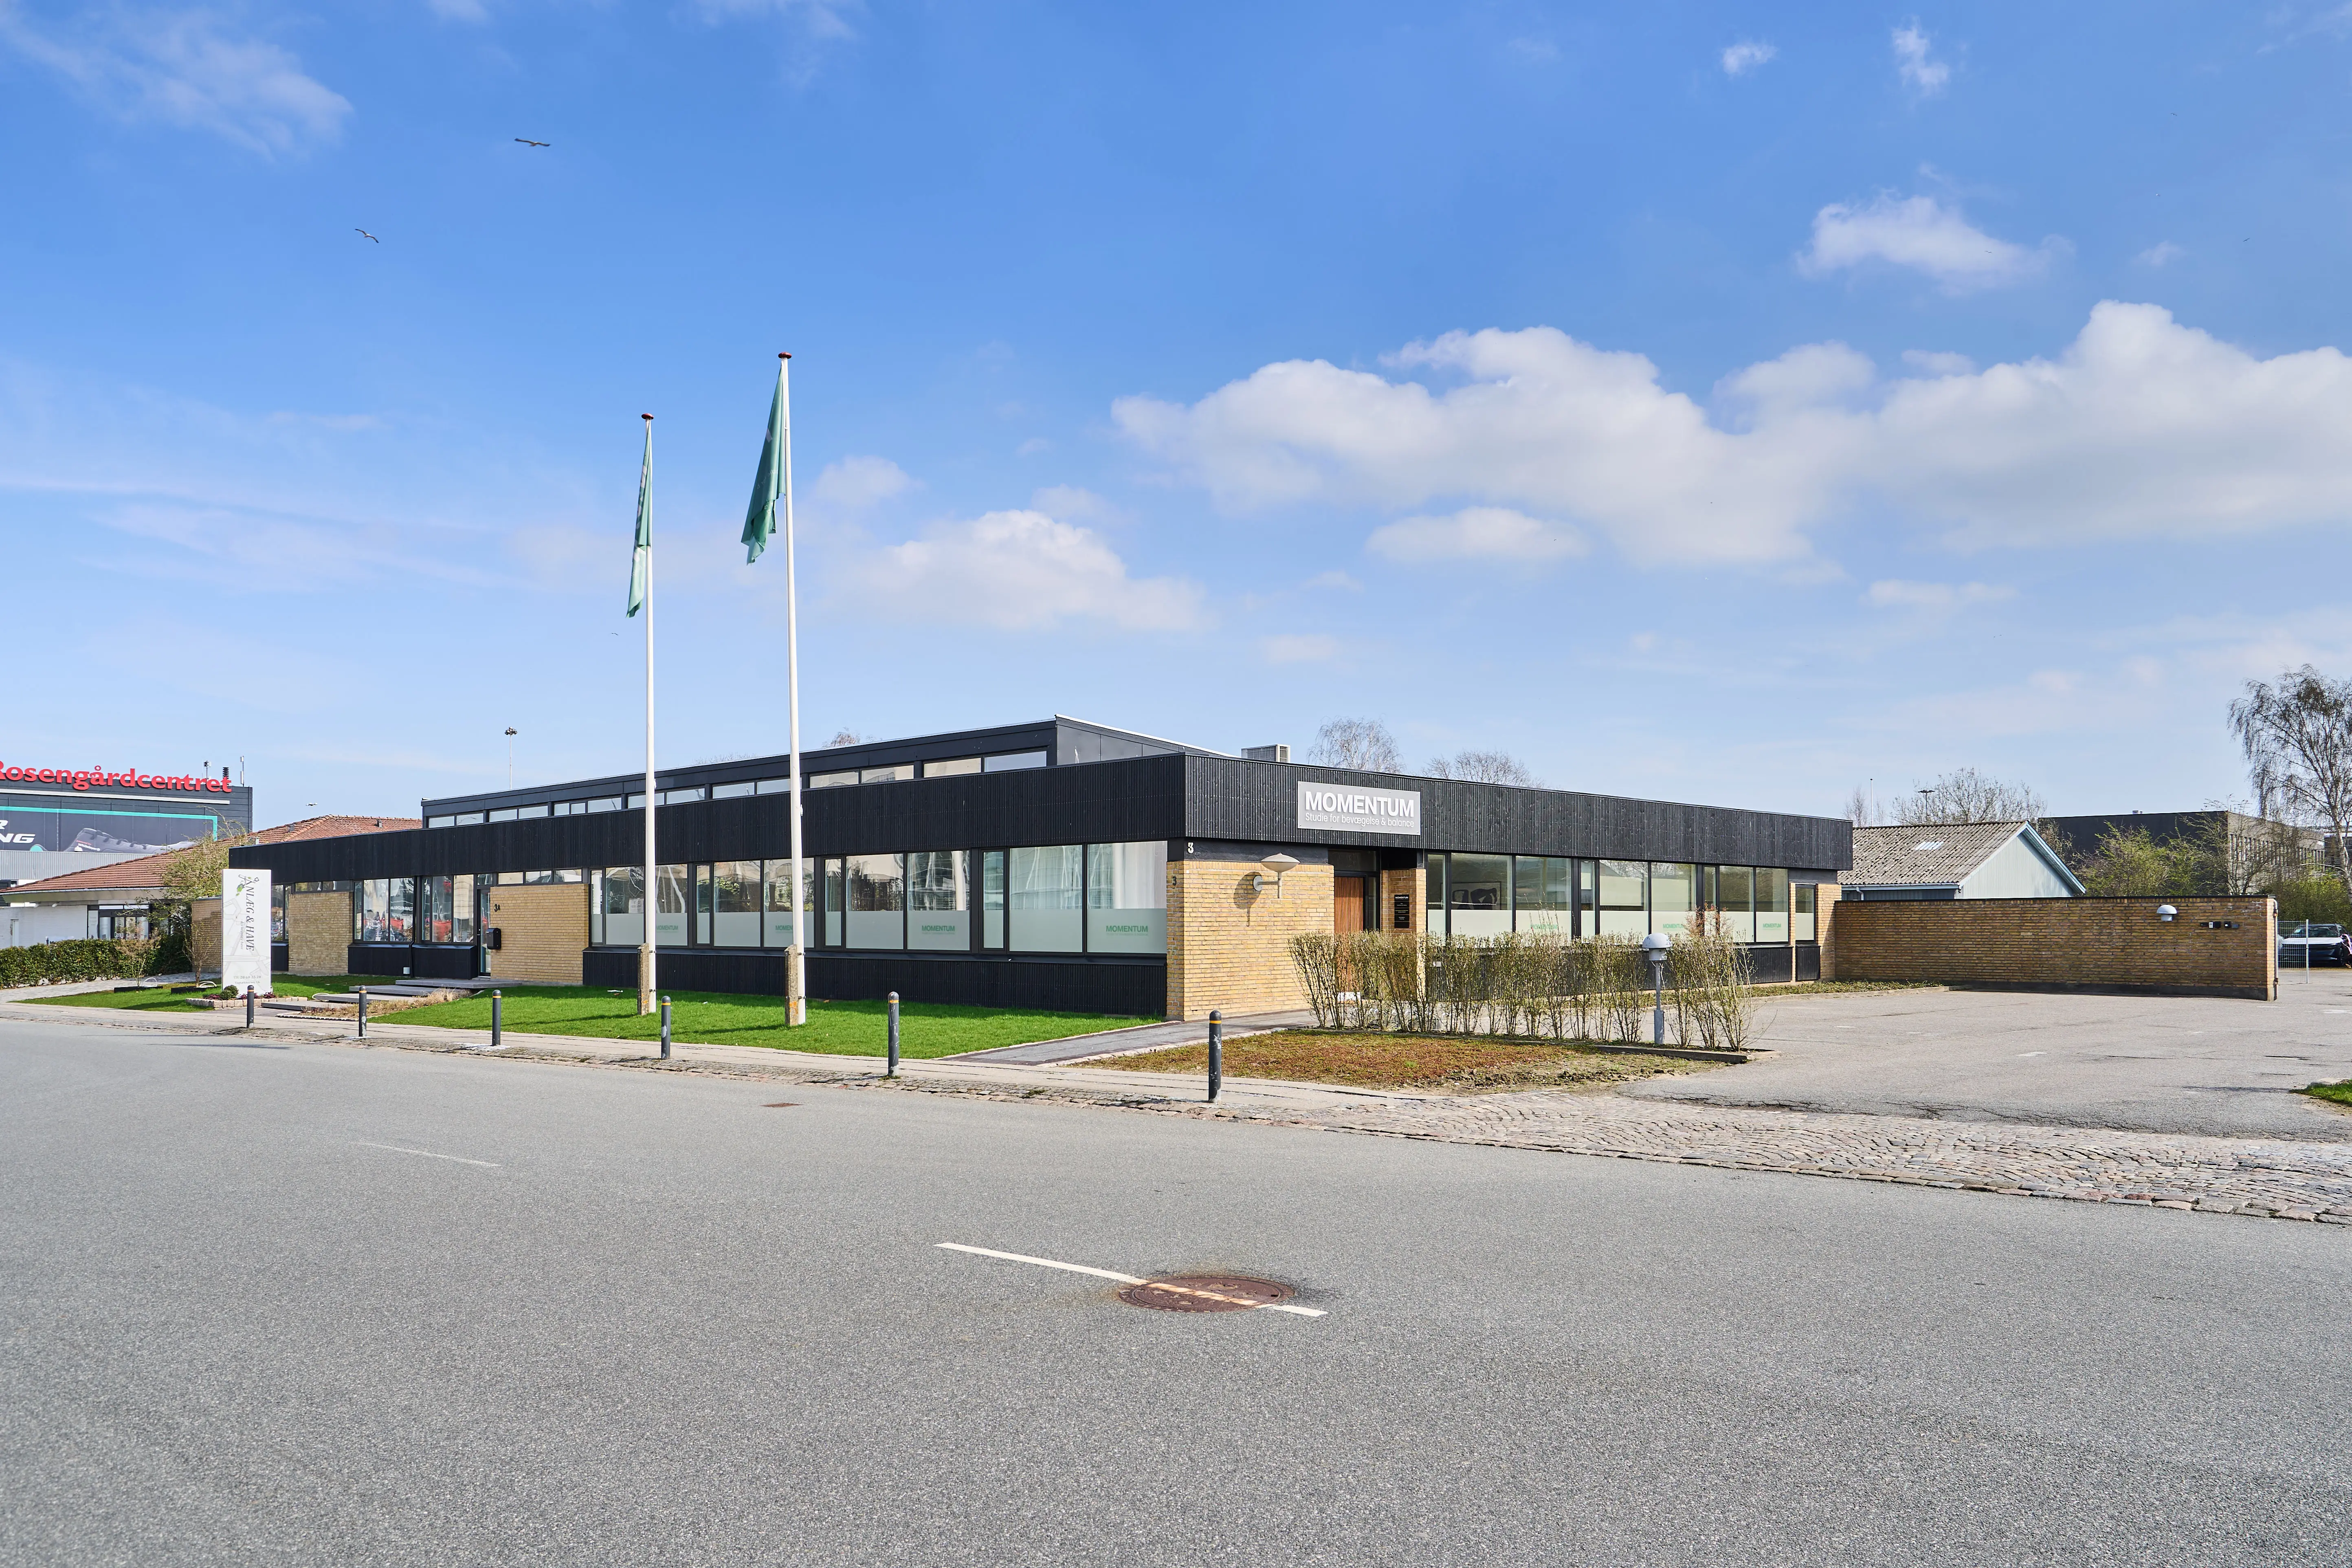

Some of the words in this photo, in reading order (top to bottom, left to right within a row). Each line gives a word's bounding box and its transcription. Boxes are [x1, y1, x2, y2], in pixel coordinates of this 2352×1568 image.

[1306, 791, 1414, 817] MOMENTUM
[1306, 812, 1328, 822] Studie
[1330, 814, 1340, 822] for
[1341, 814, 1379, 827] bevægelse
[1381, 817, 1386, 826] &
[1387, 818, 1414, 827] balance
[1187, 842, 1194, 854] 3
[1172, 876, 1177, 886] 3
[494, 904, 501, 912] 3A
[246, 926, 254, 951] HAVE
